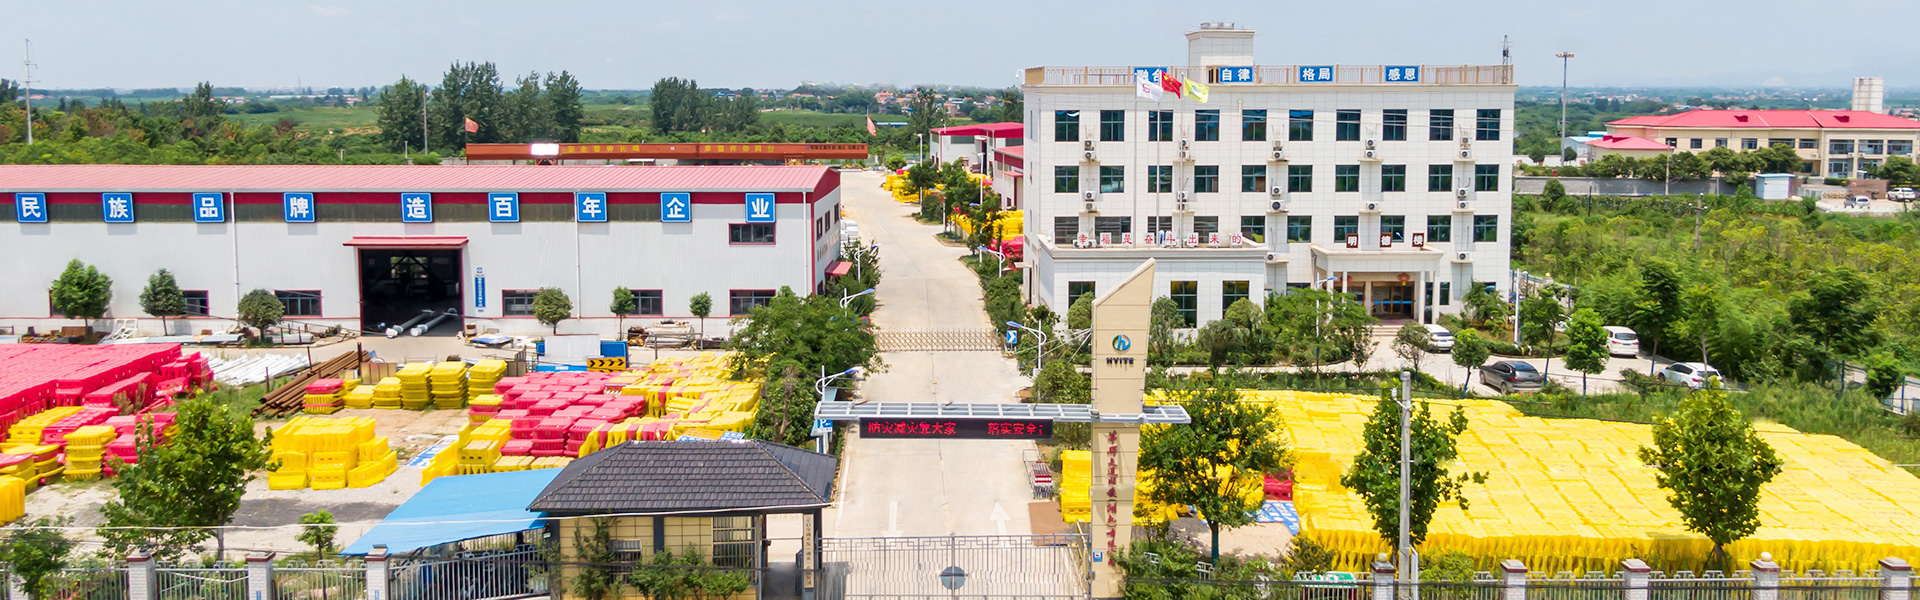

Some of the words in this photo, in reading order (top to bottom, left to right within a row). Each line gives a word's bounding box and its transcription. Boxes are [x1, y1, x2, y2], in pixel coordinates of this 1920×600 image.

[1222, 68, 1250, 81] 自律
[1302, 67, 1330, 81] 格局
[1388, 67, 1416, 81] 感恩
[20, 196, 774, 219] 民族品牌造百年企业
[1078, 233, 1242, 246] 幸福是奋斗出来的
[987, 422, 1044, 436] 落实安全
